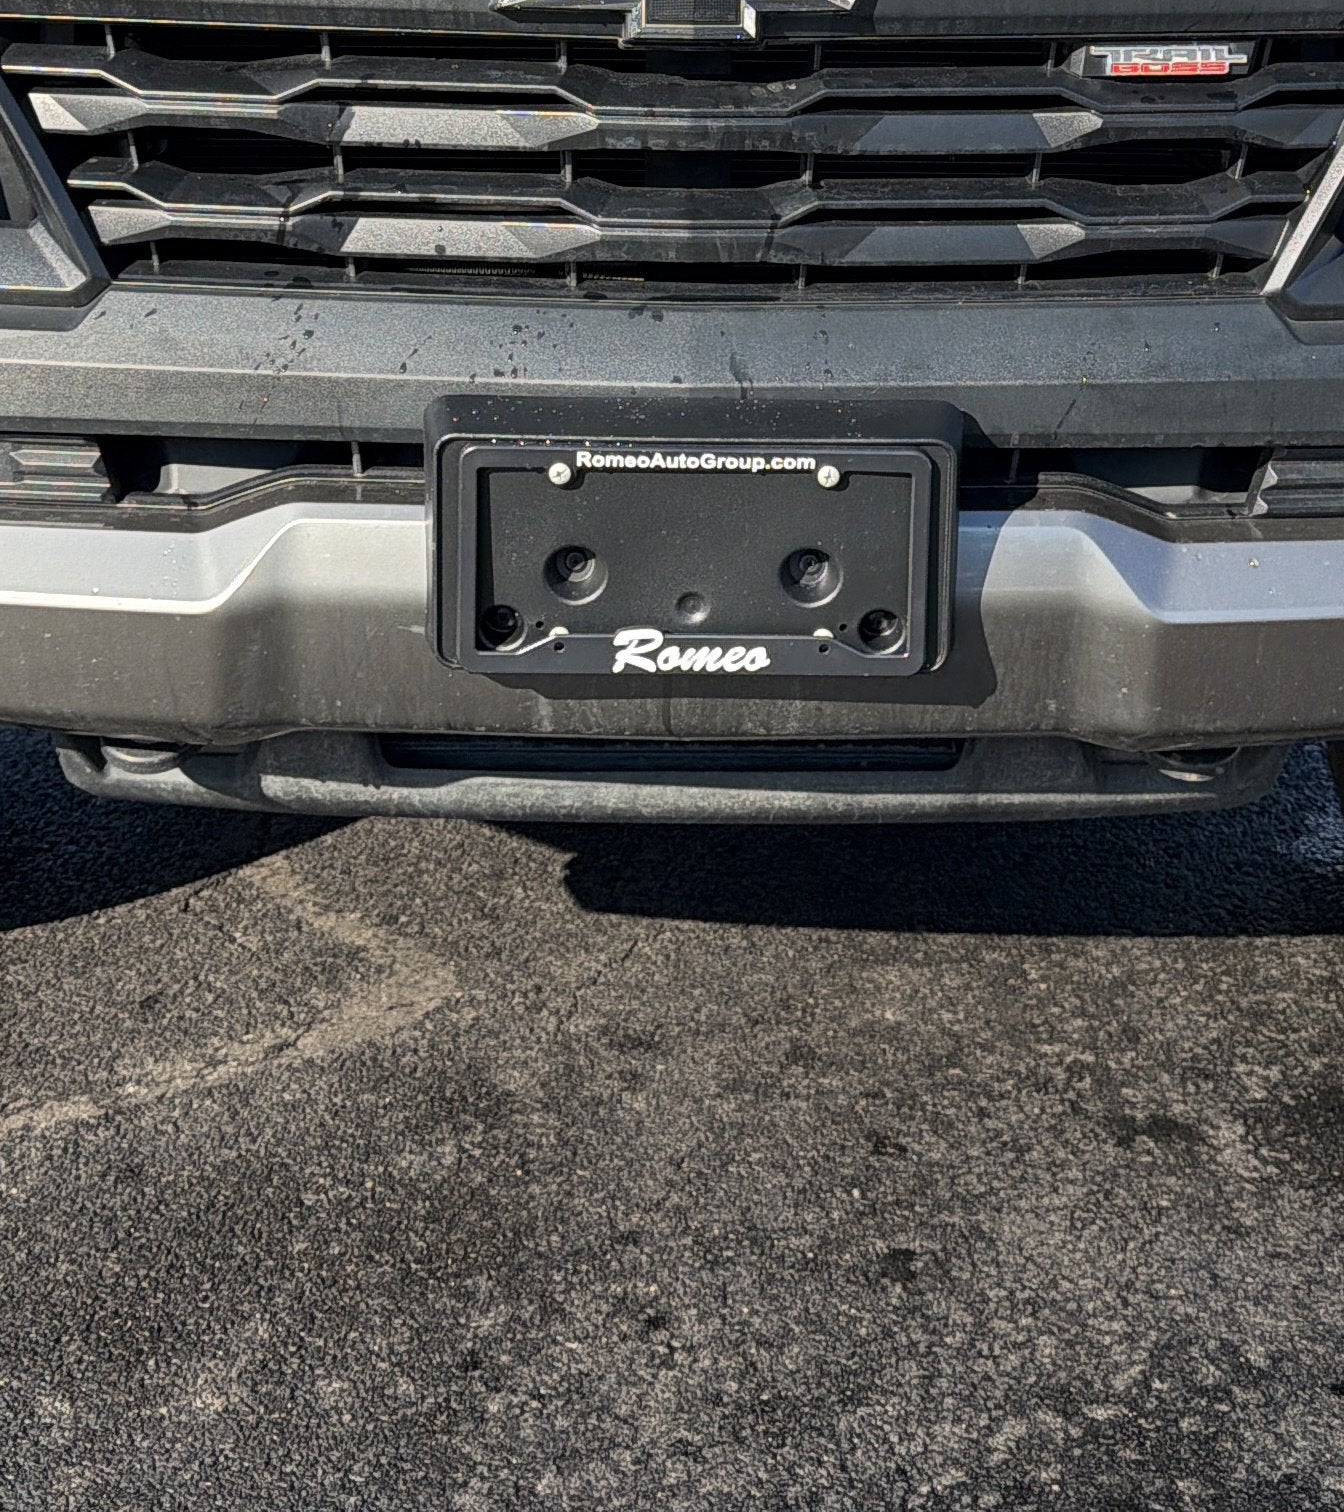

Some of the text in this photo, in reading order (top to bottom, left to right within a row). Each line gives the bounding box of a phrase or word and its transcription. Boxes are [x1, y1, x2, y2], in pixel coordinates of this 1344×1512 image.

[1090, 44, 1248, 65] TRAIL
[1110, 62, 1229, 76] BOSS
[576, 450, 816, 473] RomeoAutoGroup.com
[612, 628, 771, 674] Romeo
